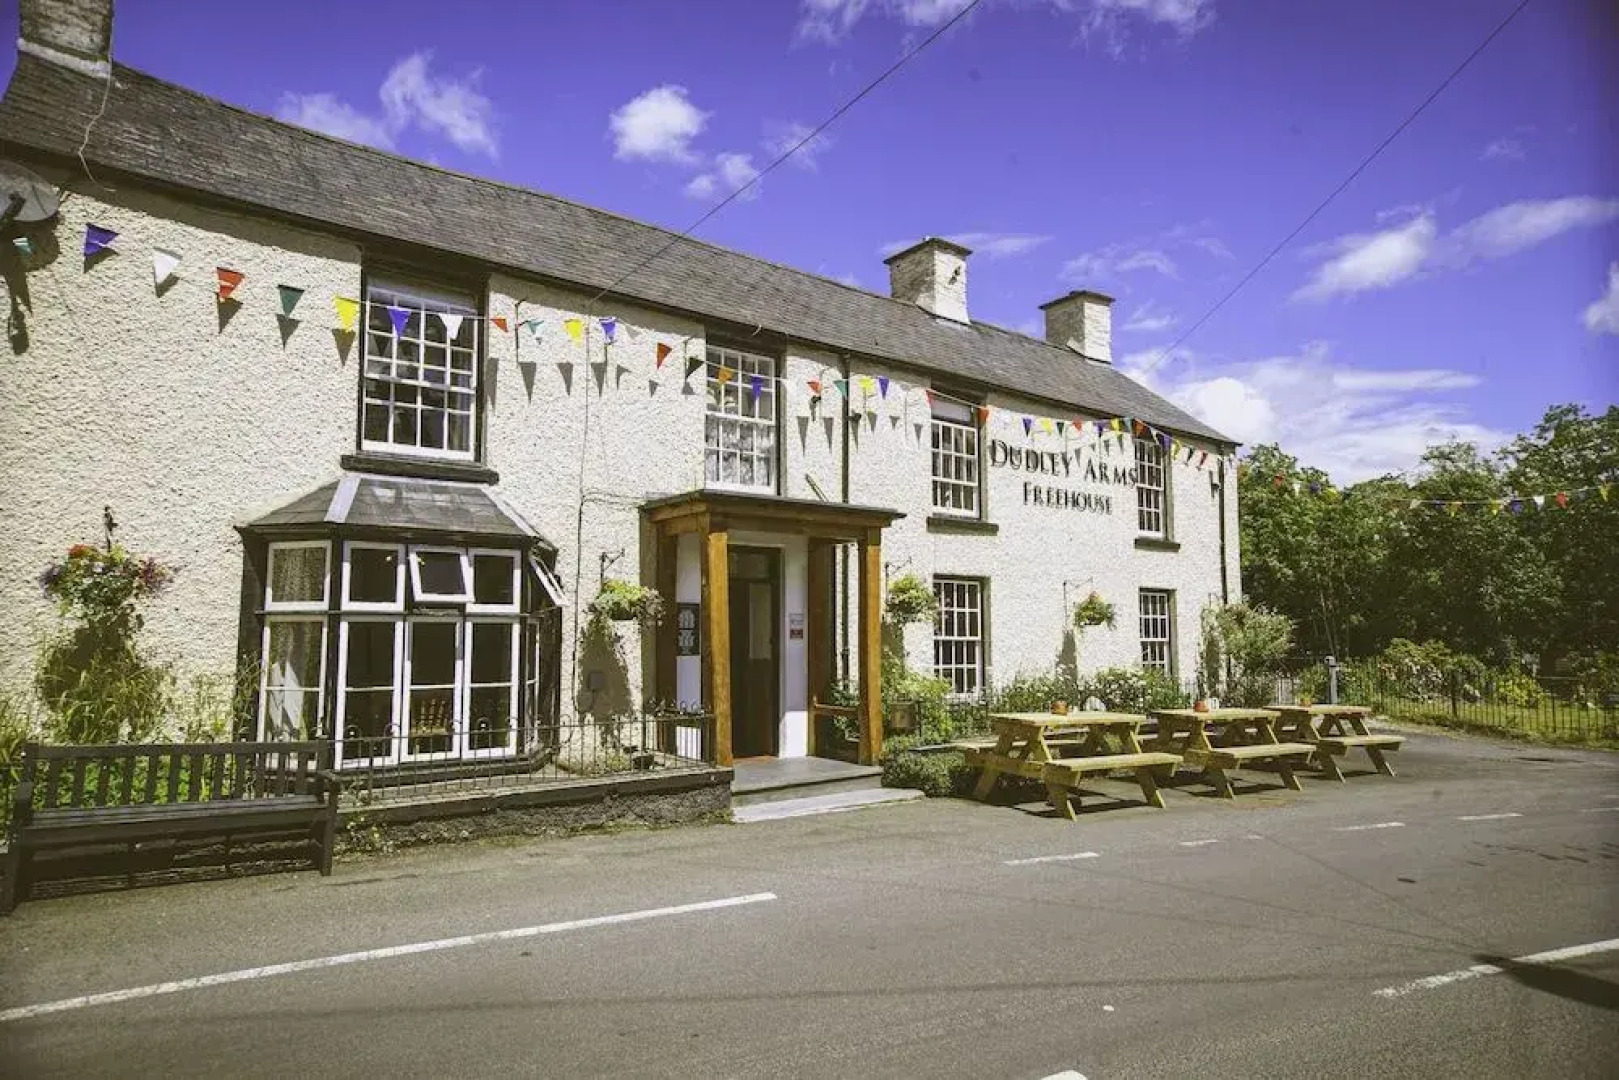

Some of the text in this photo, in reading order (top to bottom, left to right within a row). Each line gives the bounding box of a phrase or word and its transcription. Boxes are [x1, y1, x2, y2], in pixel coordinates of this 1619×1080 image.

[991, 440, 1138, 488] DUDLEY ARMS
[1023, 481, 1113, 515] FREEHOUSE
